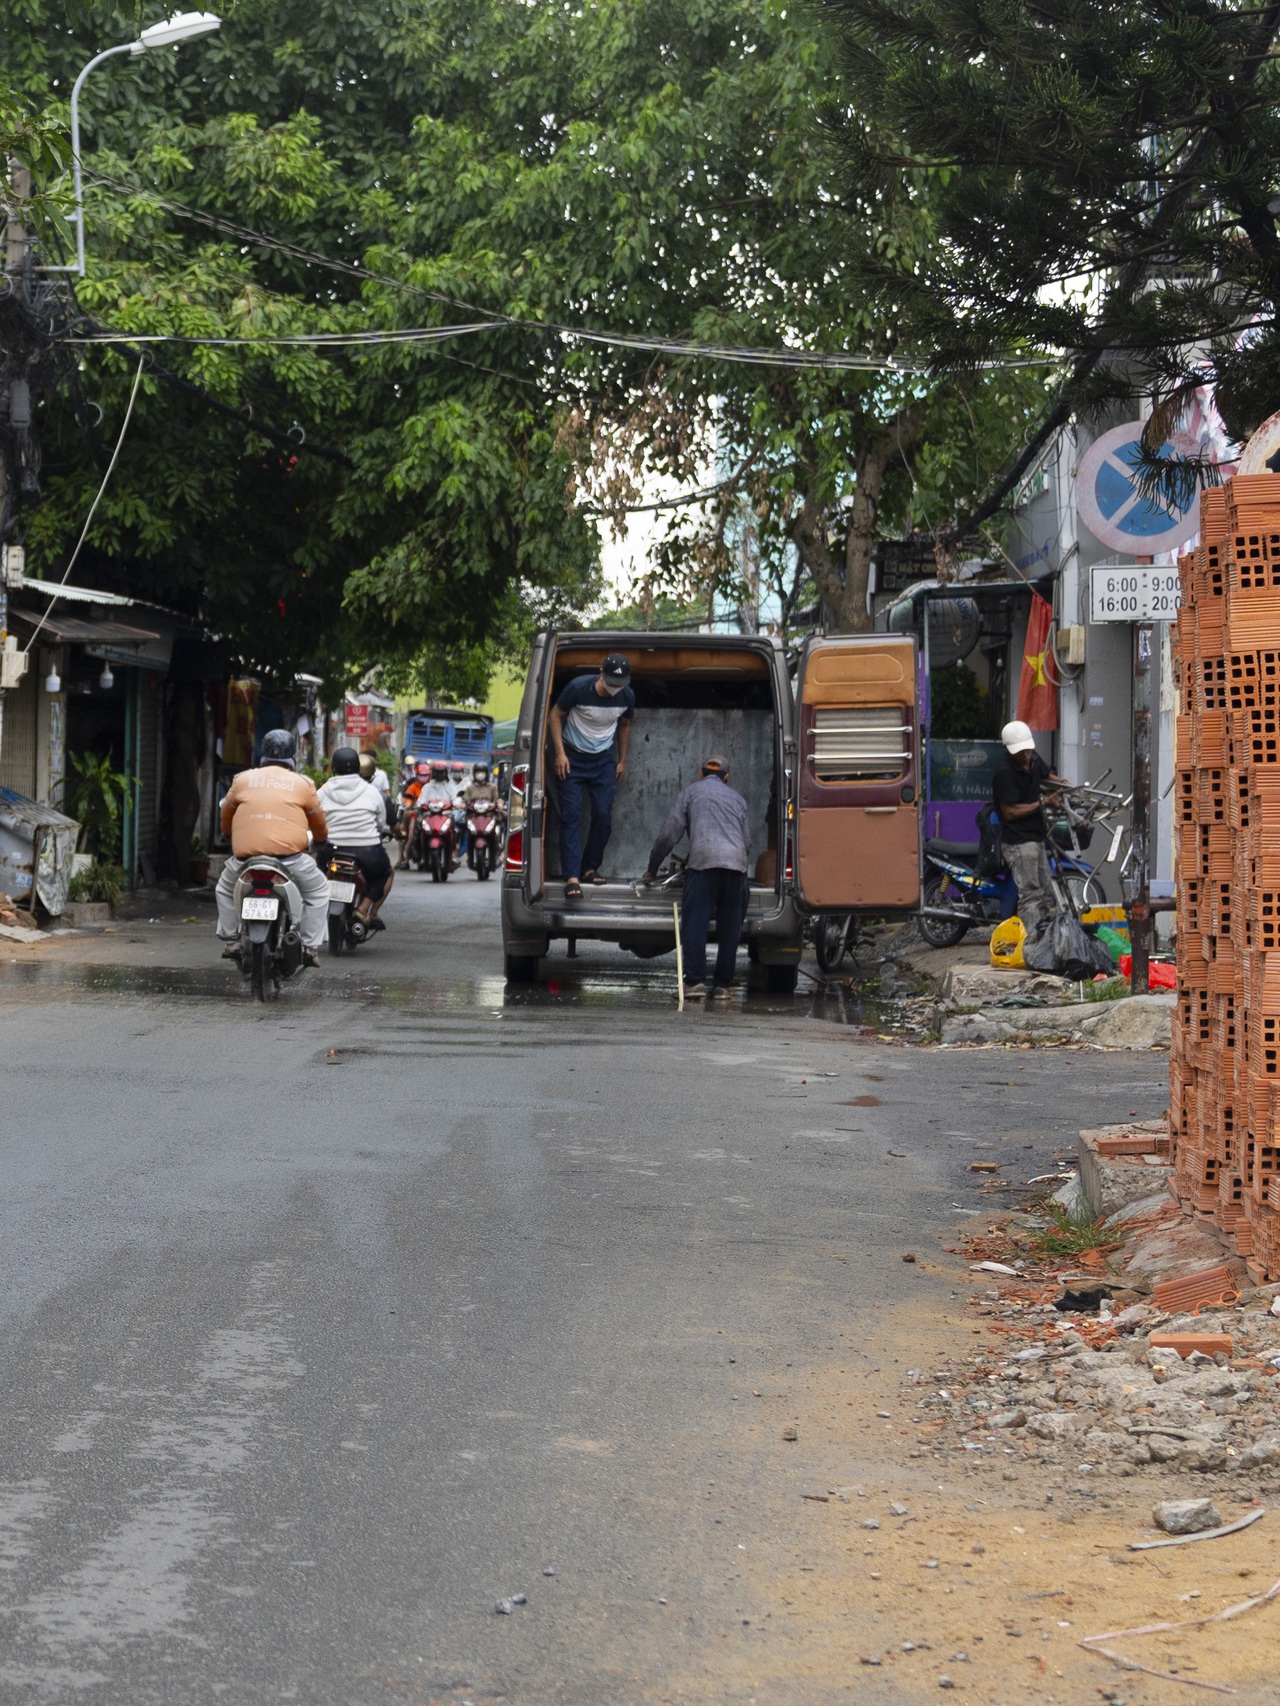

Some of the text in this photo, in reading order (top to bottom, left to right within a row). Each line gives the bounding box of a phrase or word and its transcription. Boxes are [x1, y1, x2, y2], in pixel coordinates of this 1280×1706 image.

[1106, 577, 1138, 592] 6:00
[1098, 596, 1138, 612] 16:00
[1151, 595, 1182, 611] 20:0
[266, 779, 295, 792] Food
